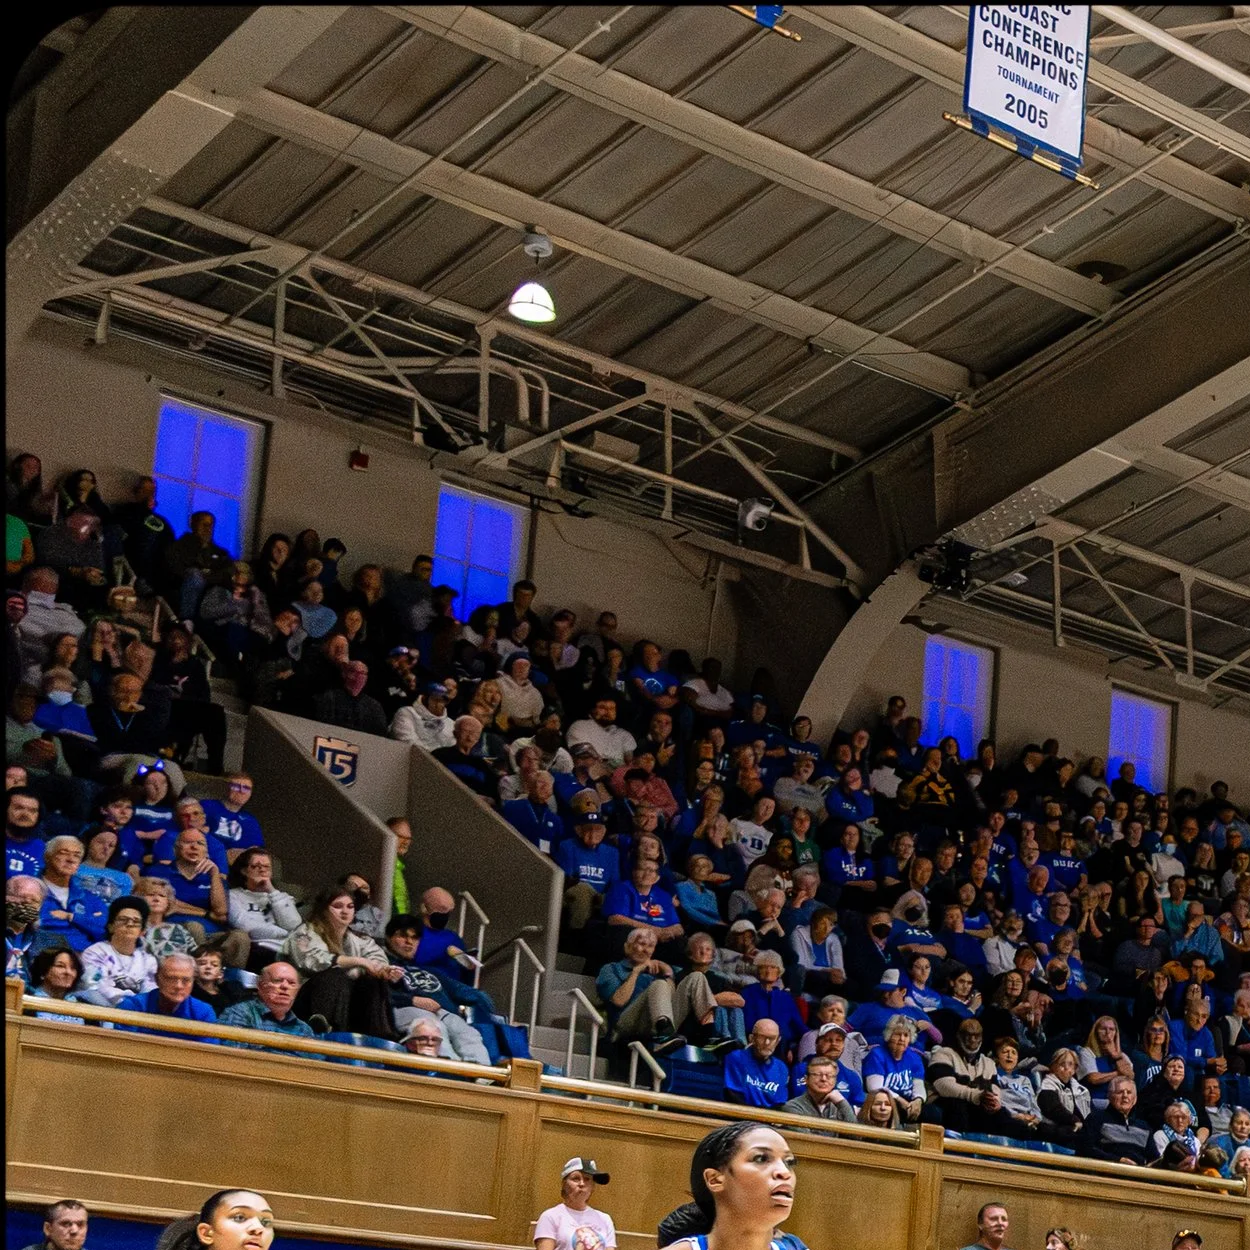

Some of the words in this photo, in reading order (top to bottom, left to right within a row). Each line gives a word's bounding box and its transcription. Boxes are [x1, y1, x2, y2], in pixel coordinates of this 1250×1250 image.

[980, 5, 1084, 70] CONFERENCE
[983, 29, 1079, 91] CHAMPIONS
[997, 65, 1060, 104] TOURNAMENT
[1005, 93, 1048, 129] 2005
[323, 751, 353, 780] 15
